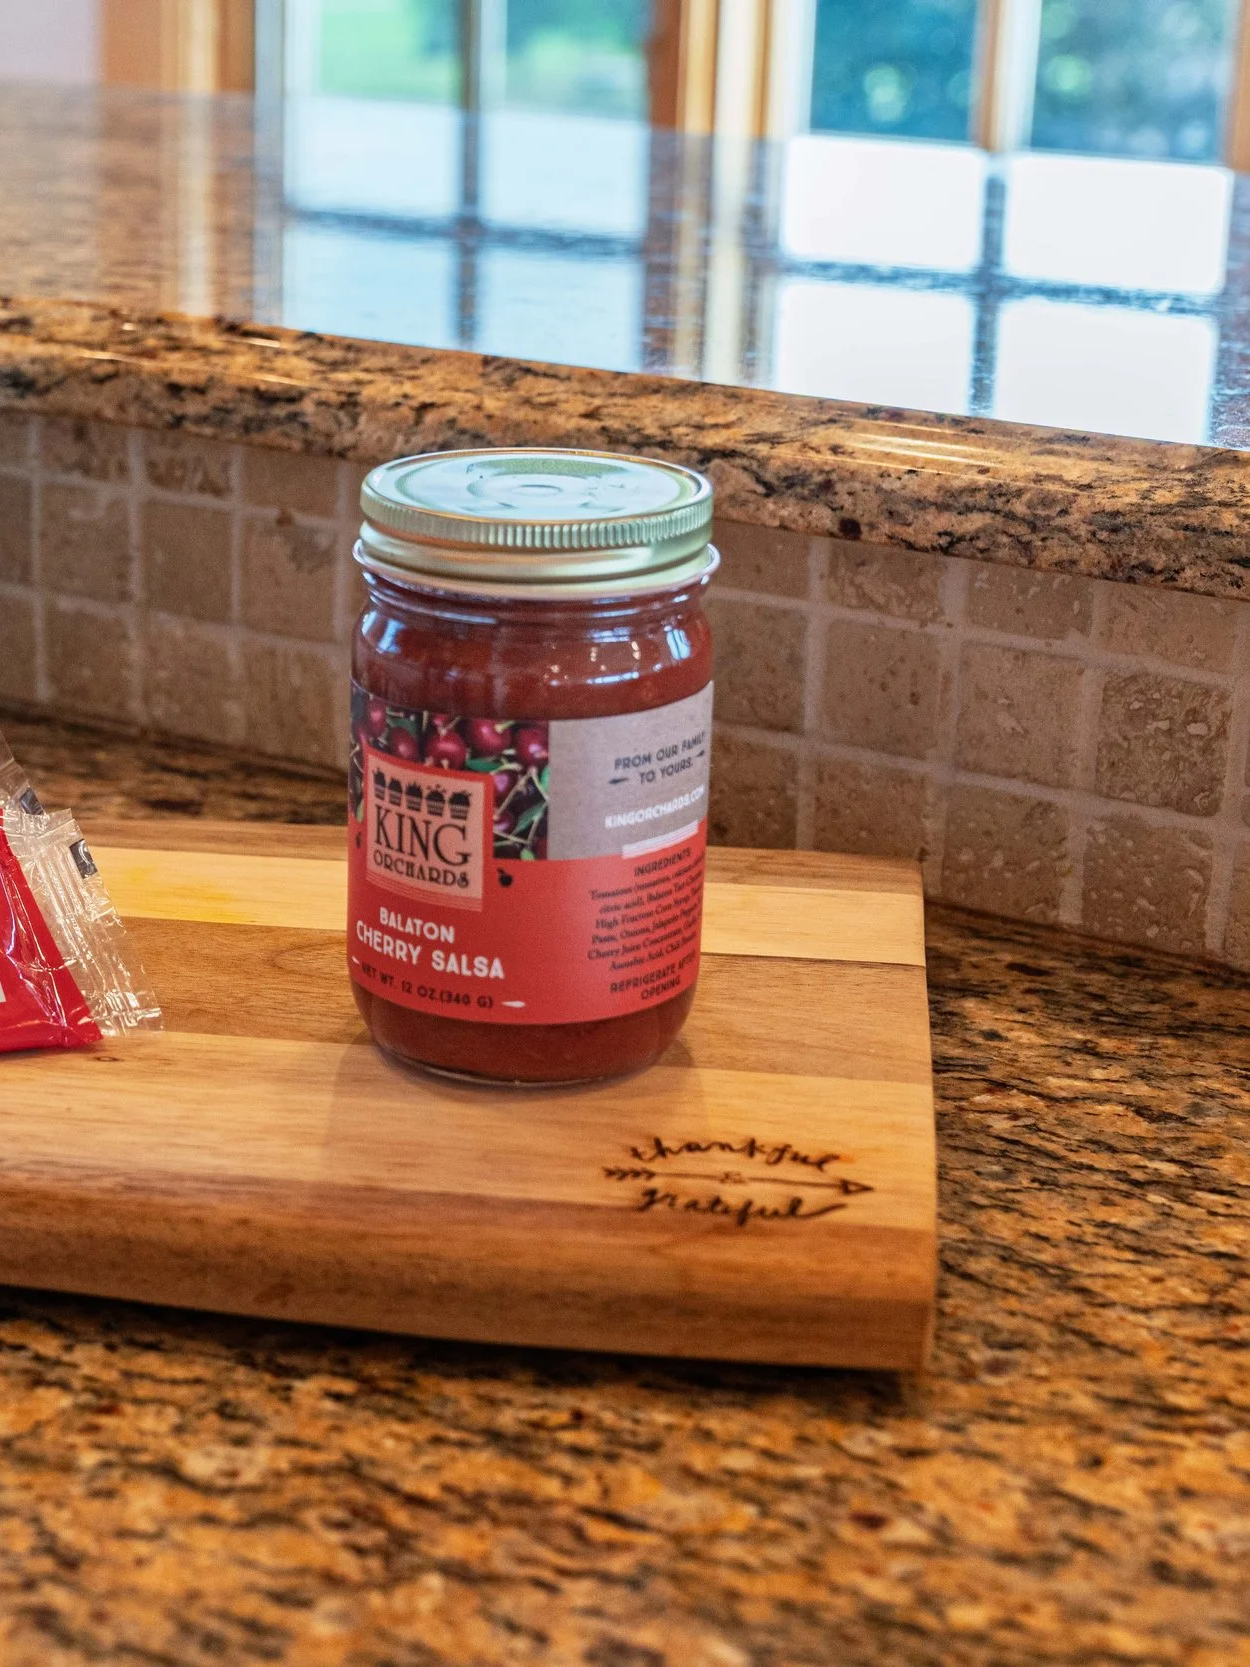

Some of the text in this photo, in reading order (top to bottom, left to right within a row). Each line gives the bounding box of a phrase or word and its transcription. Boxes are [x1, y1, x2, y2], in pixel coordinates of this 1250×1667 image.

[614, 752, 652, 770] FROM
[656, 744, 678, 761] OUR
[639, 770, 656, 785] TO
[373, 804, 472, 867] KING
[373, 850, 470, 889] ORCHARDS
[379, 906, 455, 943] BALATON
[356, 920, 505, 980] CHERRY SALSA
[361, 962, 376, 978] NET
[401, 979, 412, 995] 12
[476, 995, 494, 1009] G)
[641, 974, 681, 1000] OPENING
